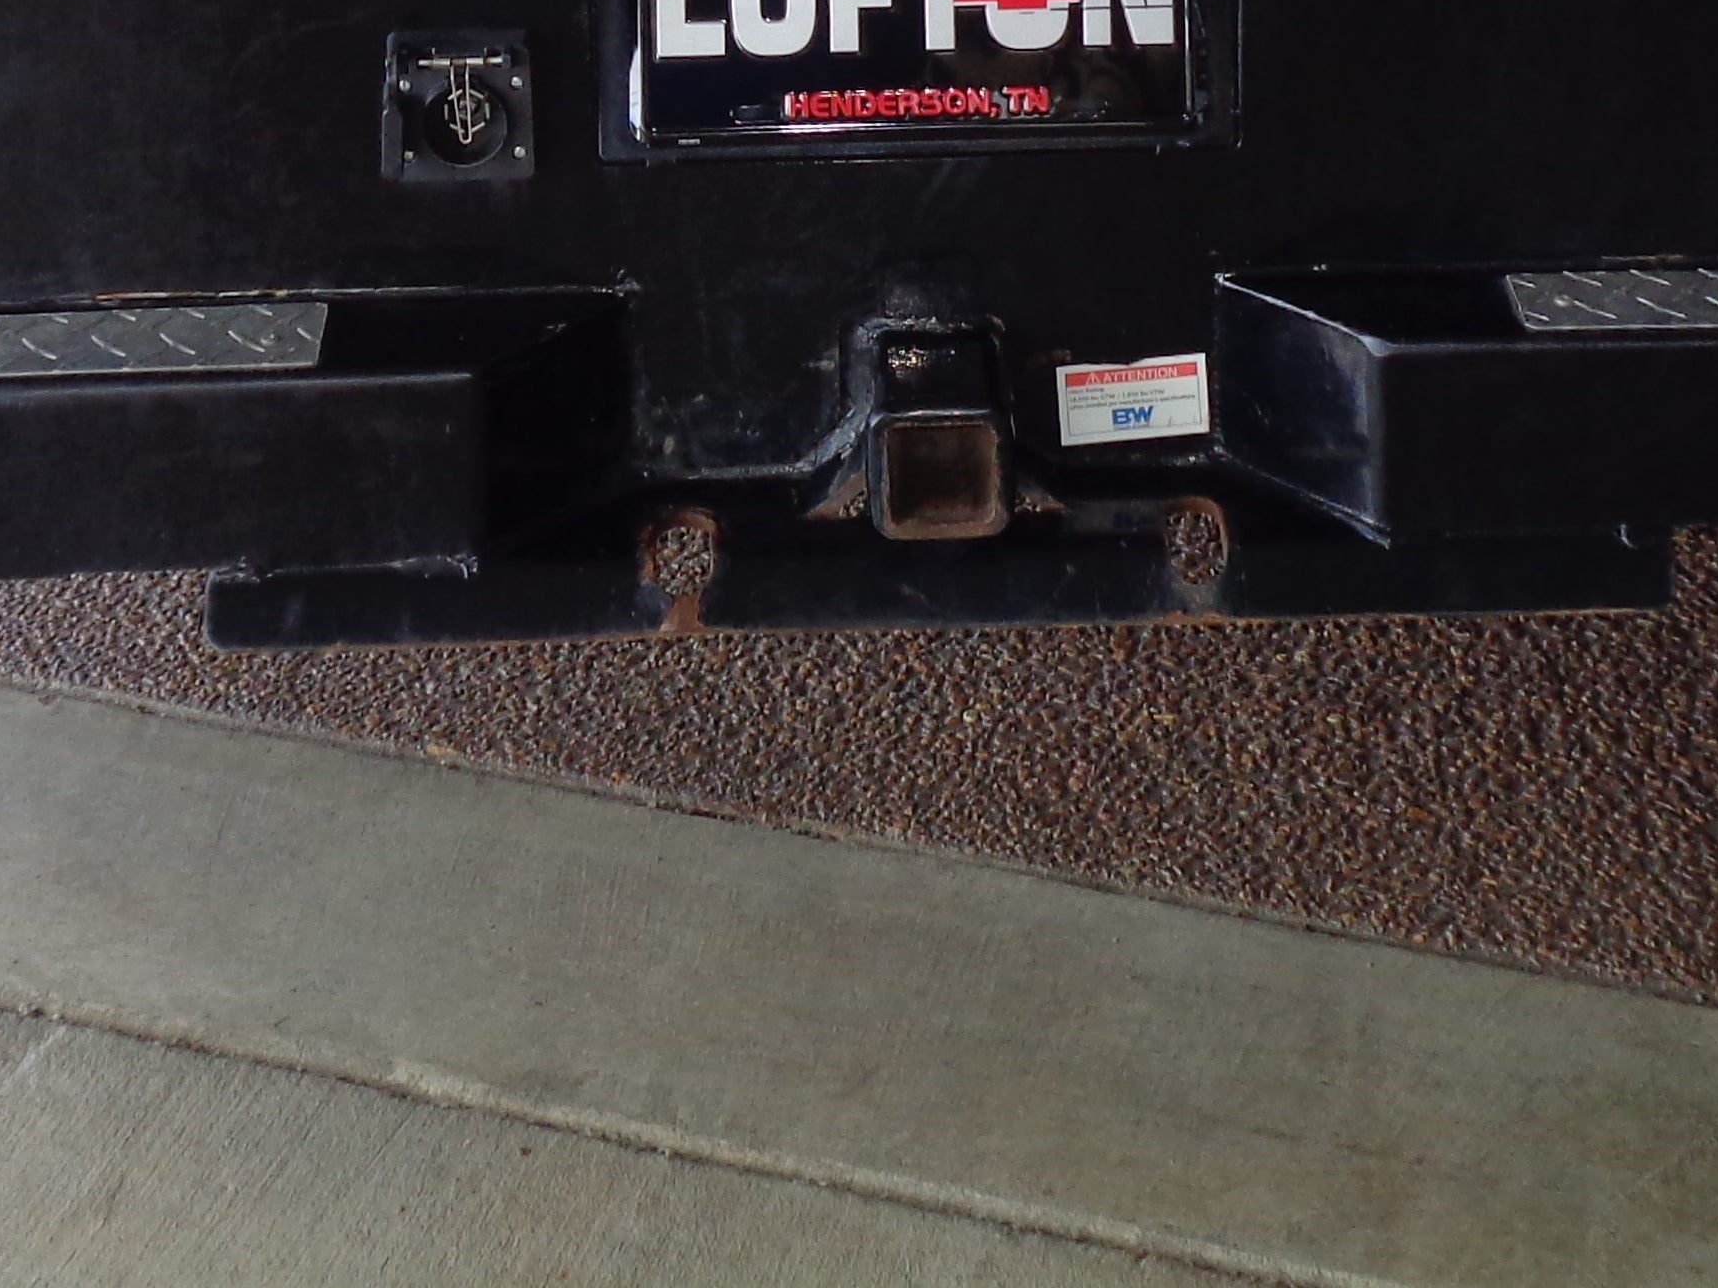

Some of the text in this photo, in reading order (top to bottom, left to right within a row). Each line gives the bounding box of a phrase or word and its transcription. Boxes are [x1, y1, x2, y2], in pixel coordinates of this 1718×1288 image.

[784, 85, 1050, 120] HENDERSON, TN
[1103, 367, 1178, 383] ATTENTION
